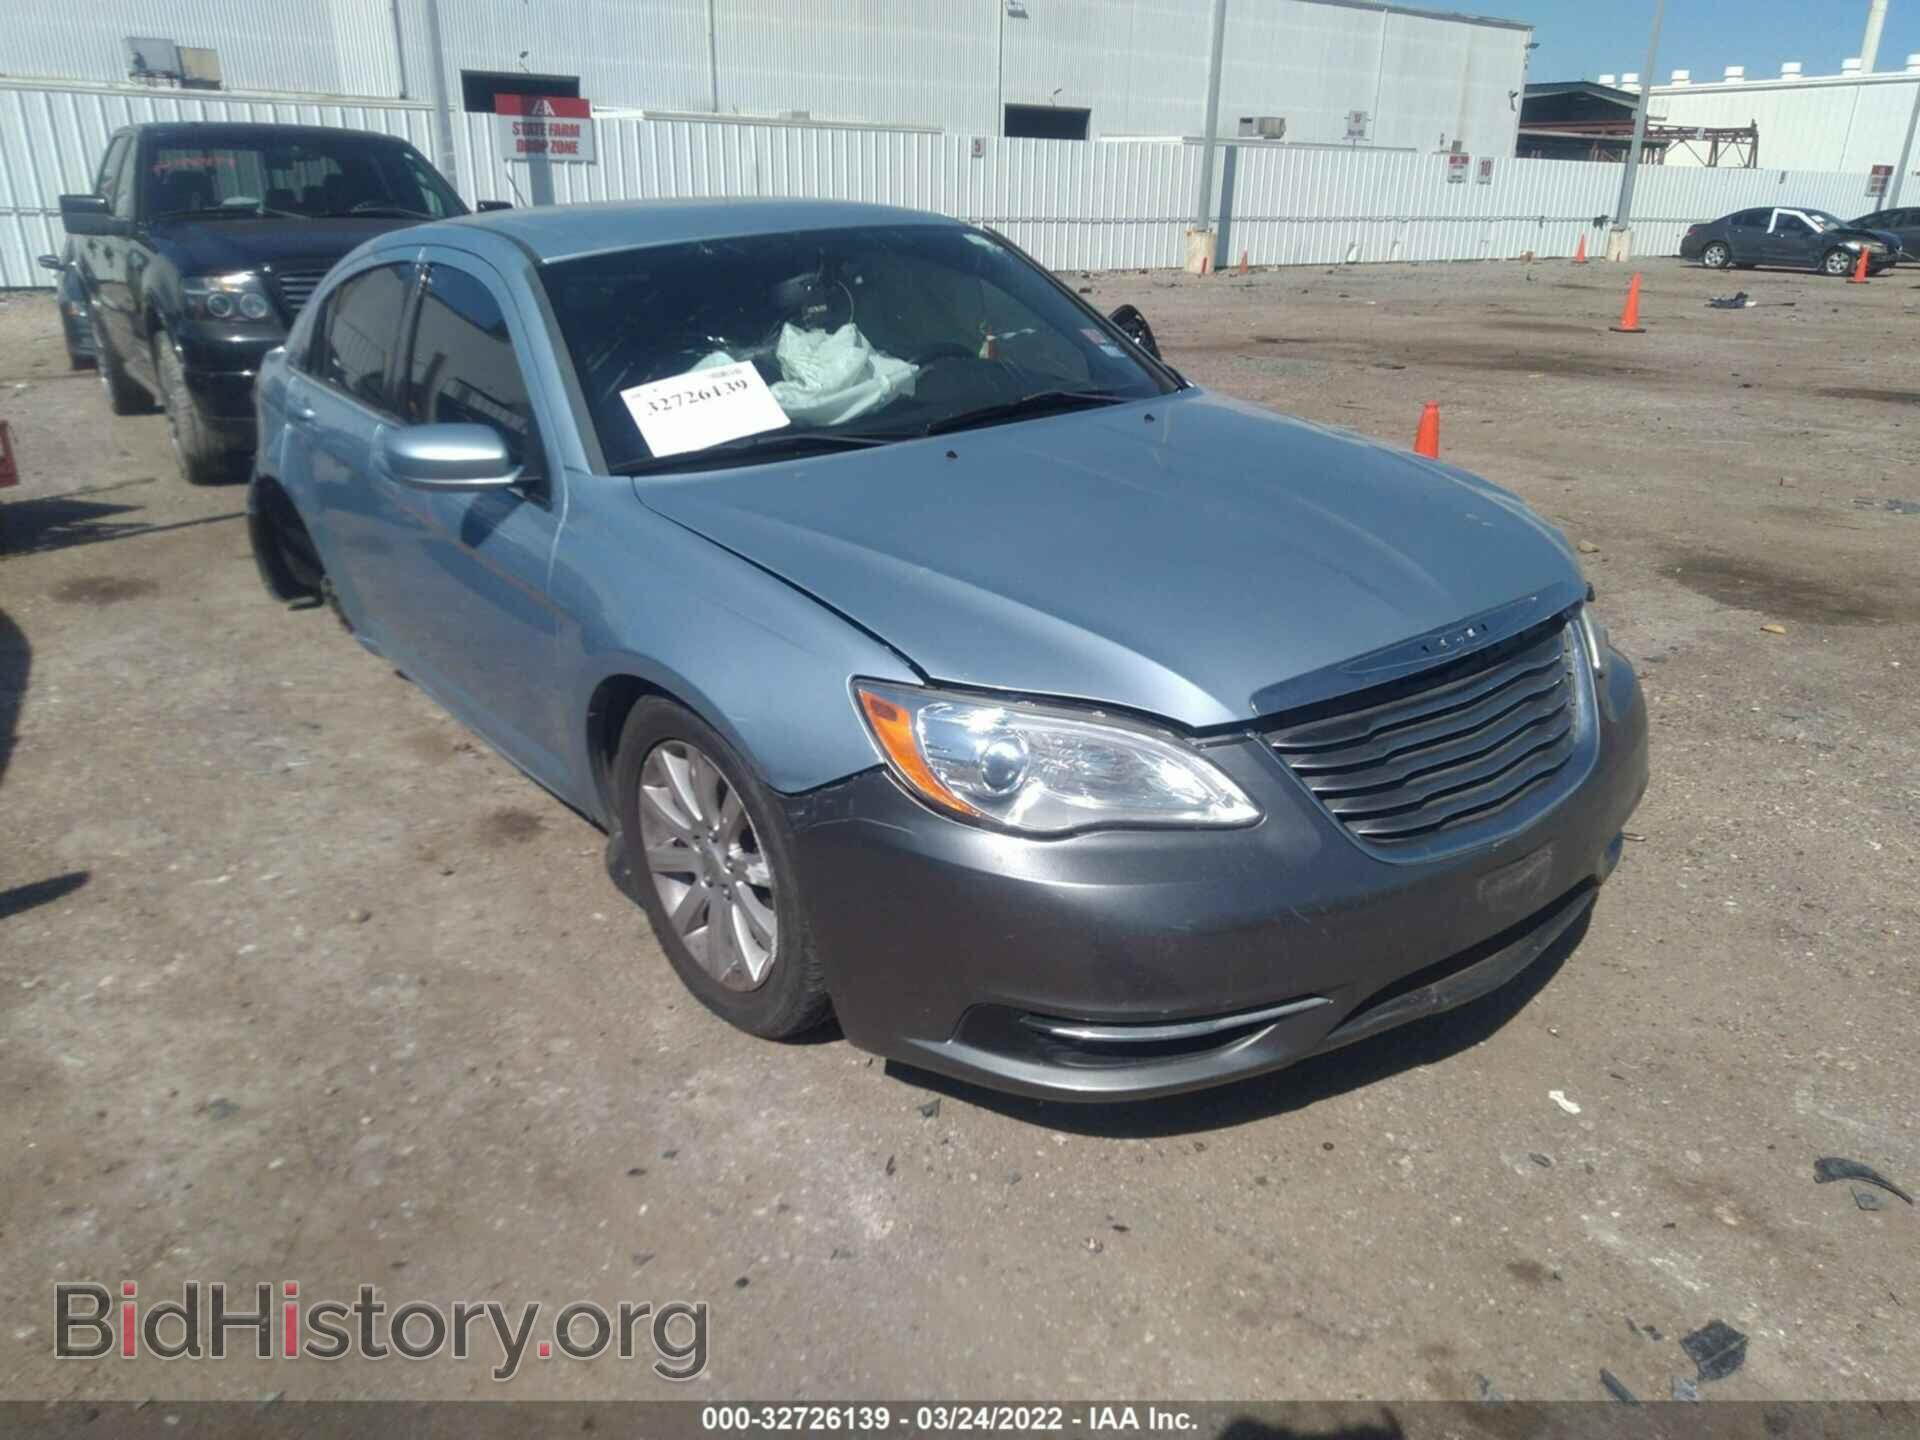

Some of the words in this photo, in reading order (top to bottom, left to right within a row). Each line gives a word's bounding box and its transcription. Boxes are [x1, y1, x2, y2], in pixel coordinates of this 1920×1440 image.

[512, 121, 546, 136] STATE
[549, 123, 580, 138] FARM
[517, 139, 548, 153] DROP
[550, 140, 578, 154] ZONE
[648, 379, 749, 415] 32726139
